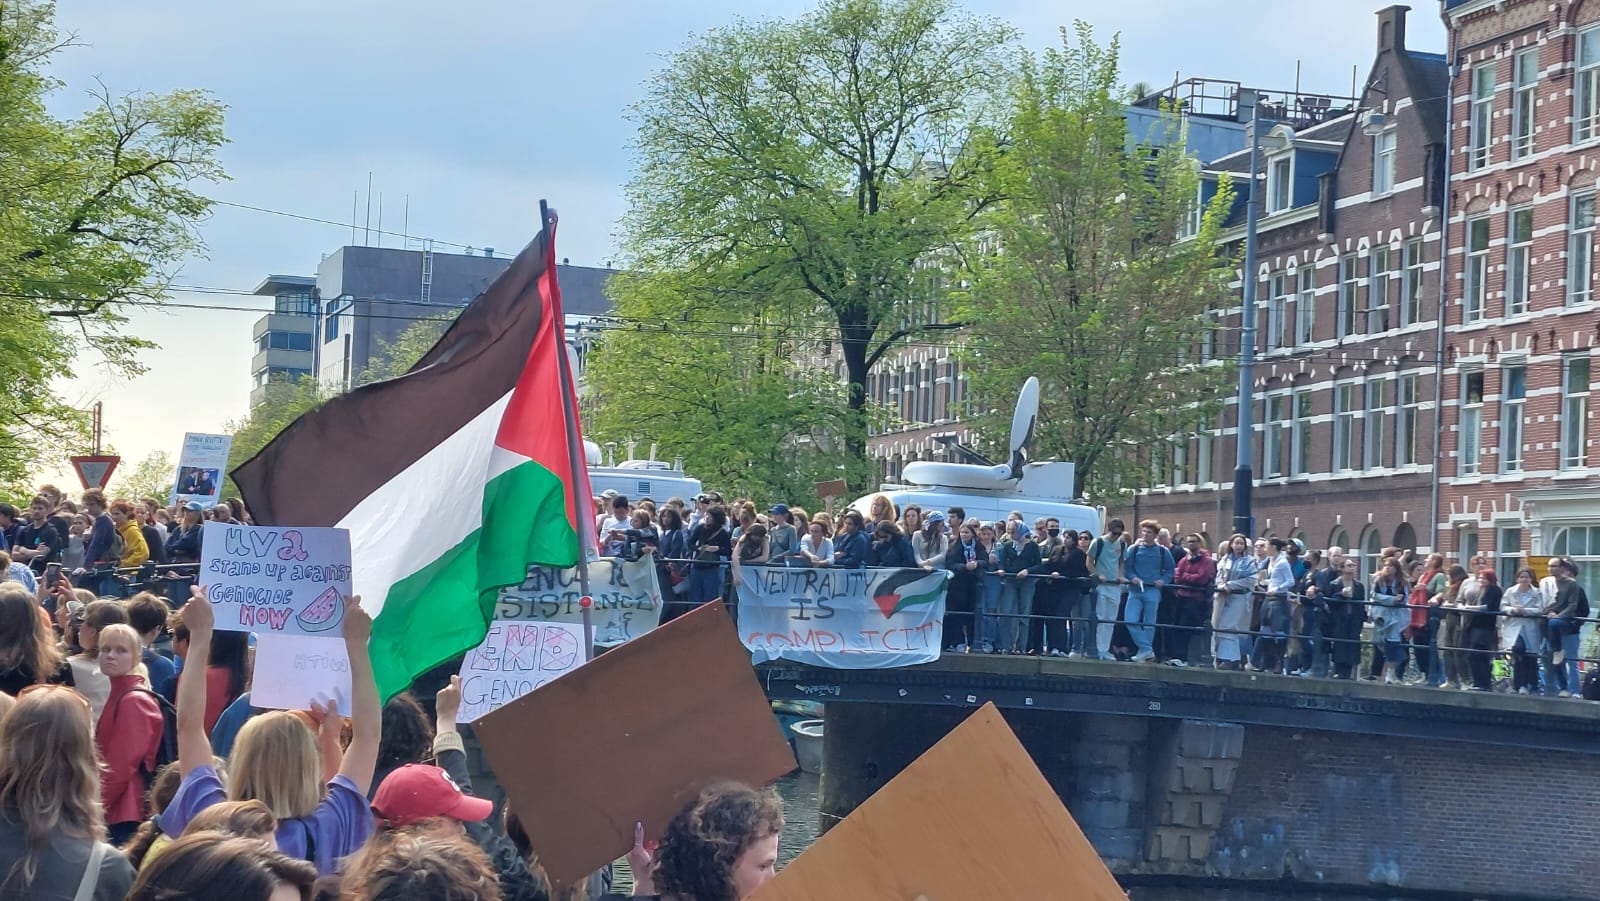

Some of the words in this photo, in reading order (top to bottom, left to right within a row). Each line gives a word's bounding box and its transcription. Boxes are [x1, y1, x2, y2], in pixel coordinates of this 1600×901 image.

[754, 568, 878, 600] NEUTRALITY
[239, 603, 294, 630] NOW
[790, 597, 835, 621] IS
[470, 624, 579, 672] END
